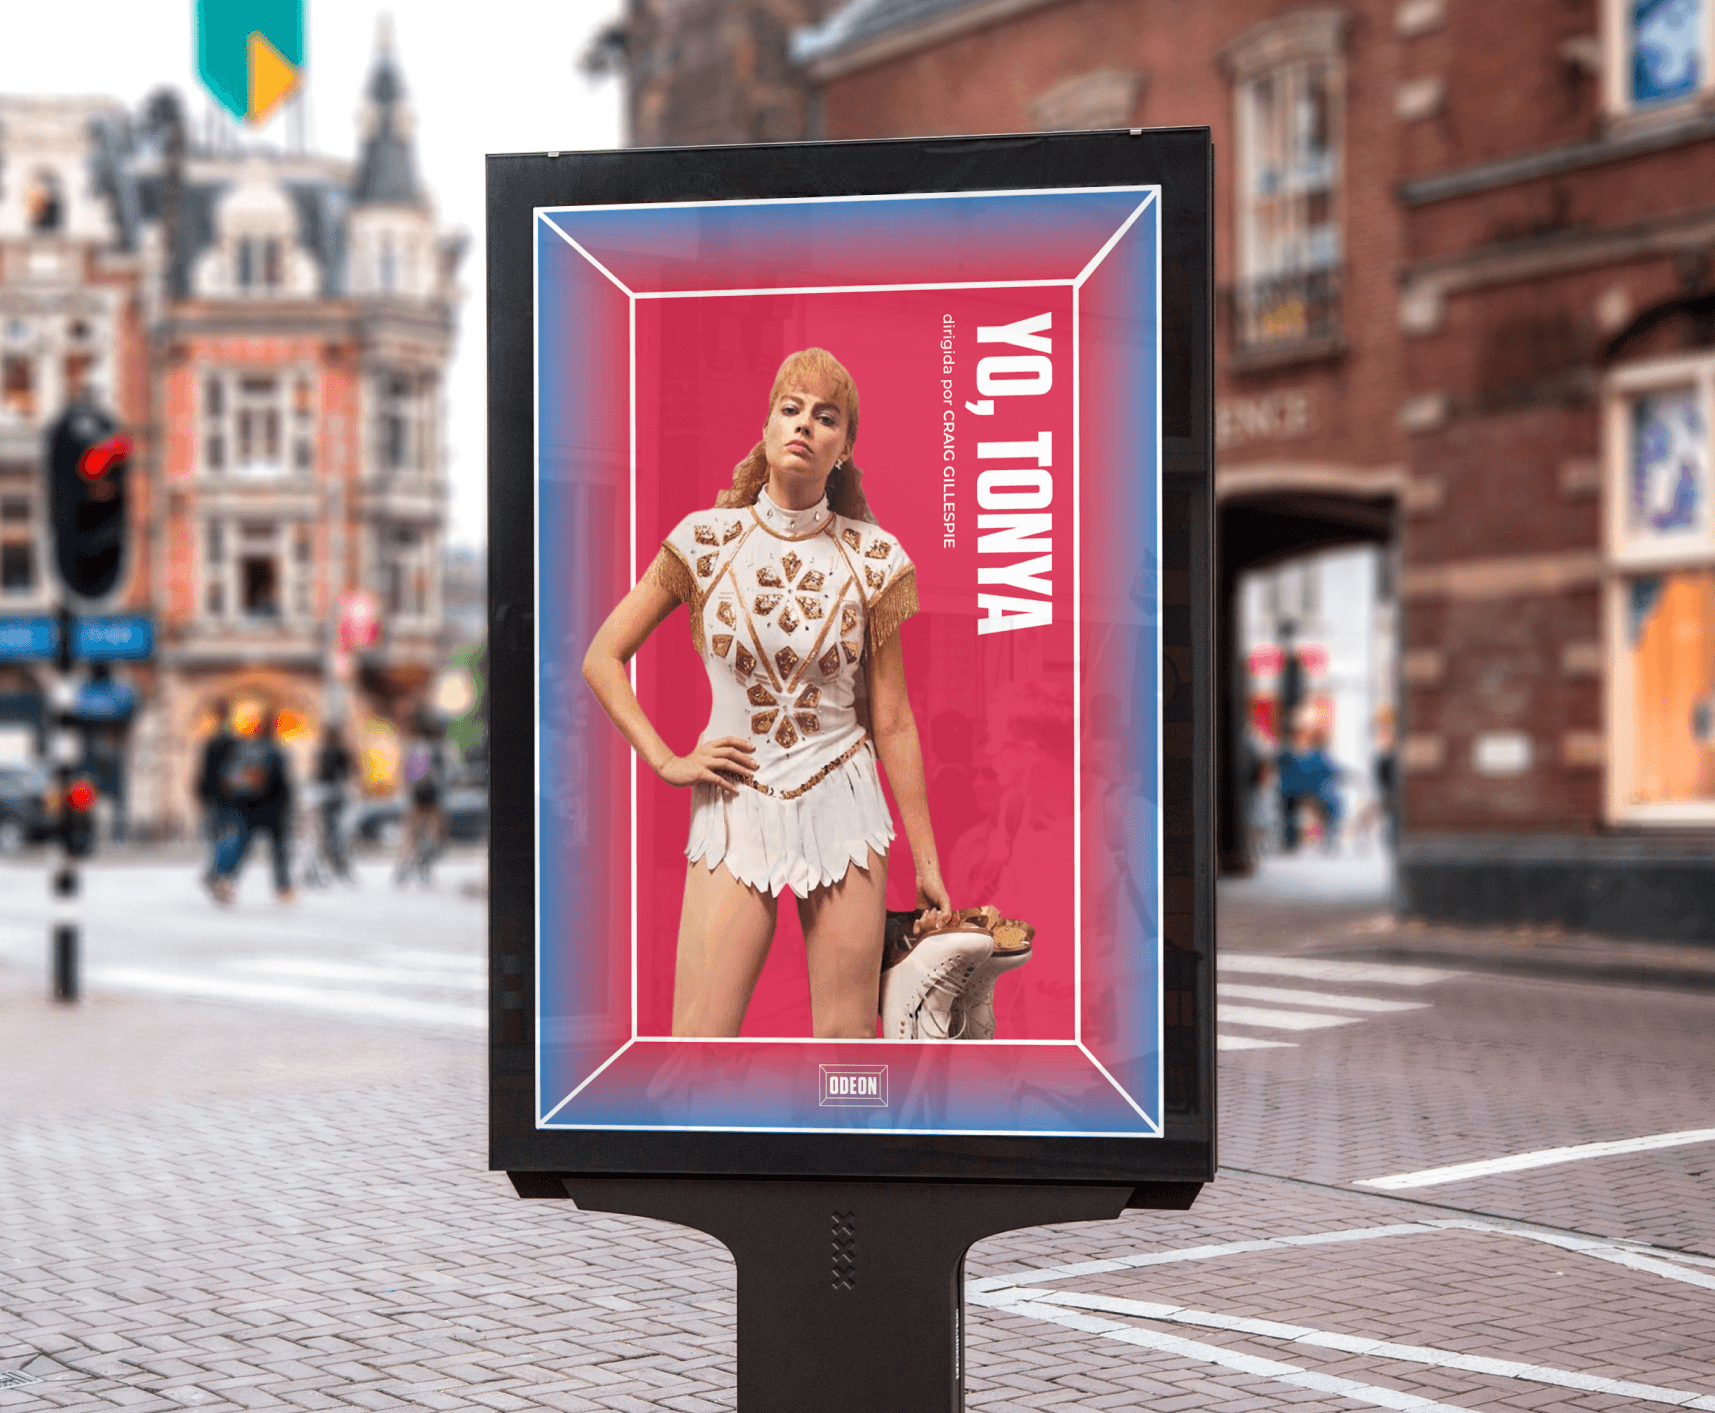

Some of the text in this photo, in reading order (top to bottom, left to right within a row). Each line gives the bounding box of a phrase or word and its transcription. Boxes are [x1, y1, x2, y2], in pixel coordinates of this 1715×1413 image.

[940, 313, 956, 549] dirigida por CRAIG GILLESPIE
[964, 311, 1053, 636] YO, TONYA
[829, 1075, 877, 1095] ODEON
